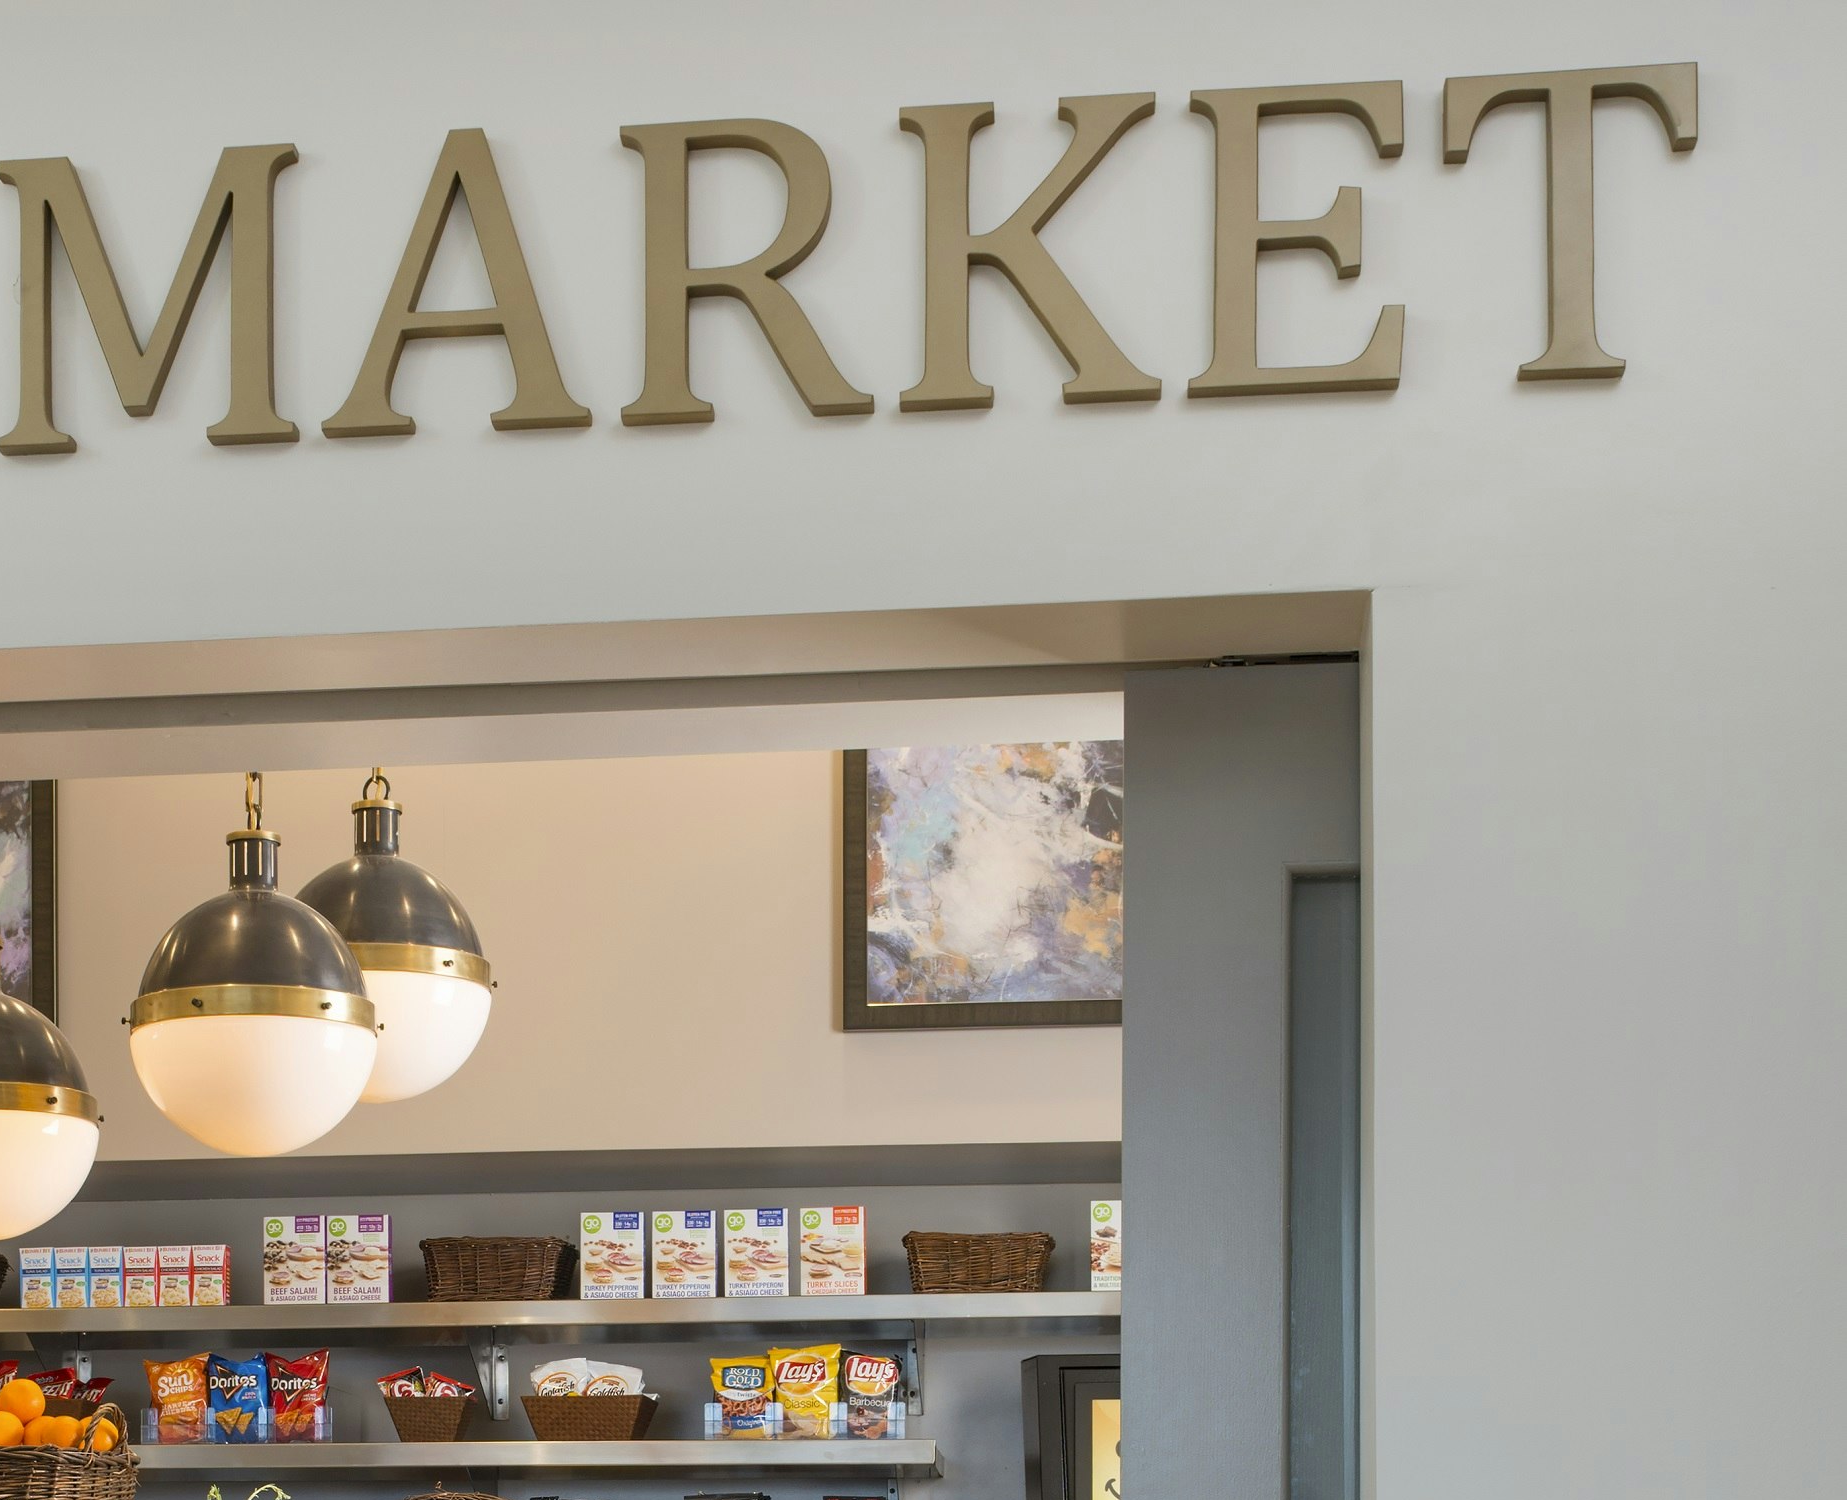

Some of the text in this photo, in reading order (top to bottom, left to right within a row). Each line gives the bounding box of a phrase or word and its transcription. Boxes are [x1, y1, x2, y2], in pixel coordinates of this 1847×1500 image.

[585, 1219, 599, 1229] go
[657, 1218, 671, 1228] go
[729, 1216, 743, 1227] go
[804, 1215, 818, 1225] go
[268, 1222, 282, 1233] go
[331, 1221, 345, 1232] go
[93, 1256, 116, 1264] Snack
[129, 1256, 151, 1264] Snack
[729, 1368, 760, 1377] ROLD
[779, 1362, 825, 1383] Lay's
[849, 1357, 896, 1382] Lay's
[158, 1374, 193, 1397] Sun
[210, 1375, 257, 1389] Doritos
[272, 1378, 317, 1390] Doritos
[726, 1375, 762, 1387] GOLD
[170, 1385, 194, 1394] CHIPS
[784, 1398, 820, 1409] Classic
